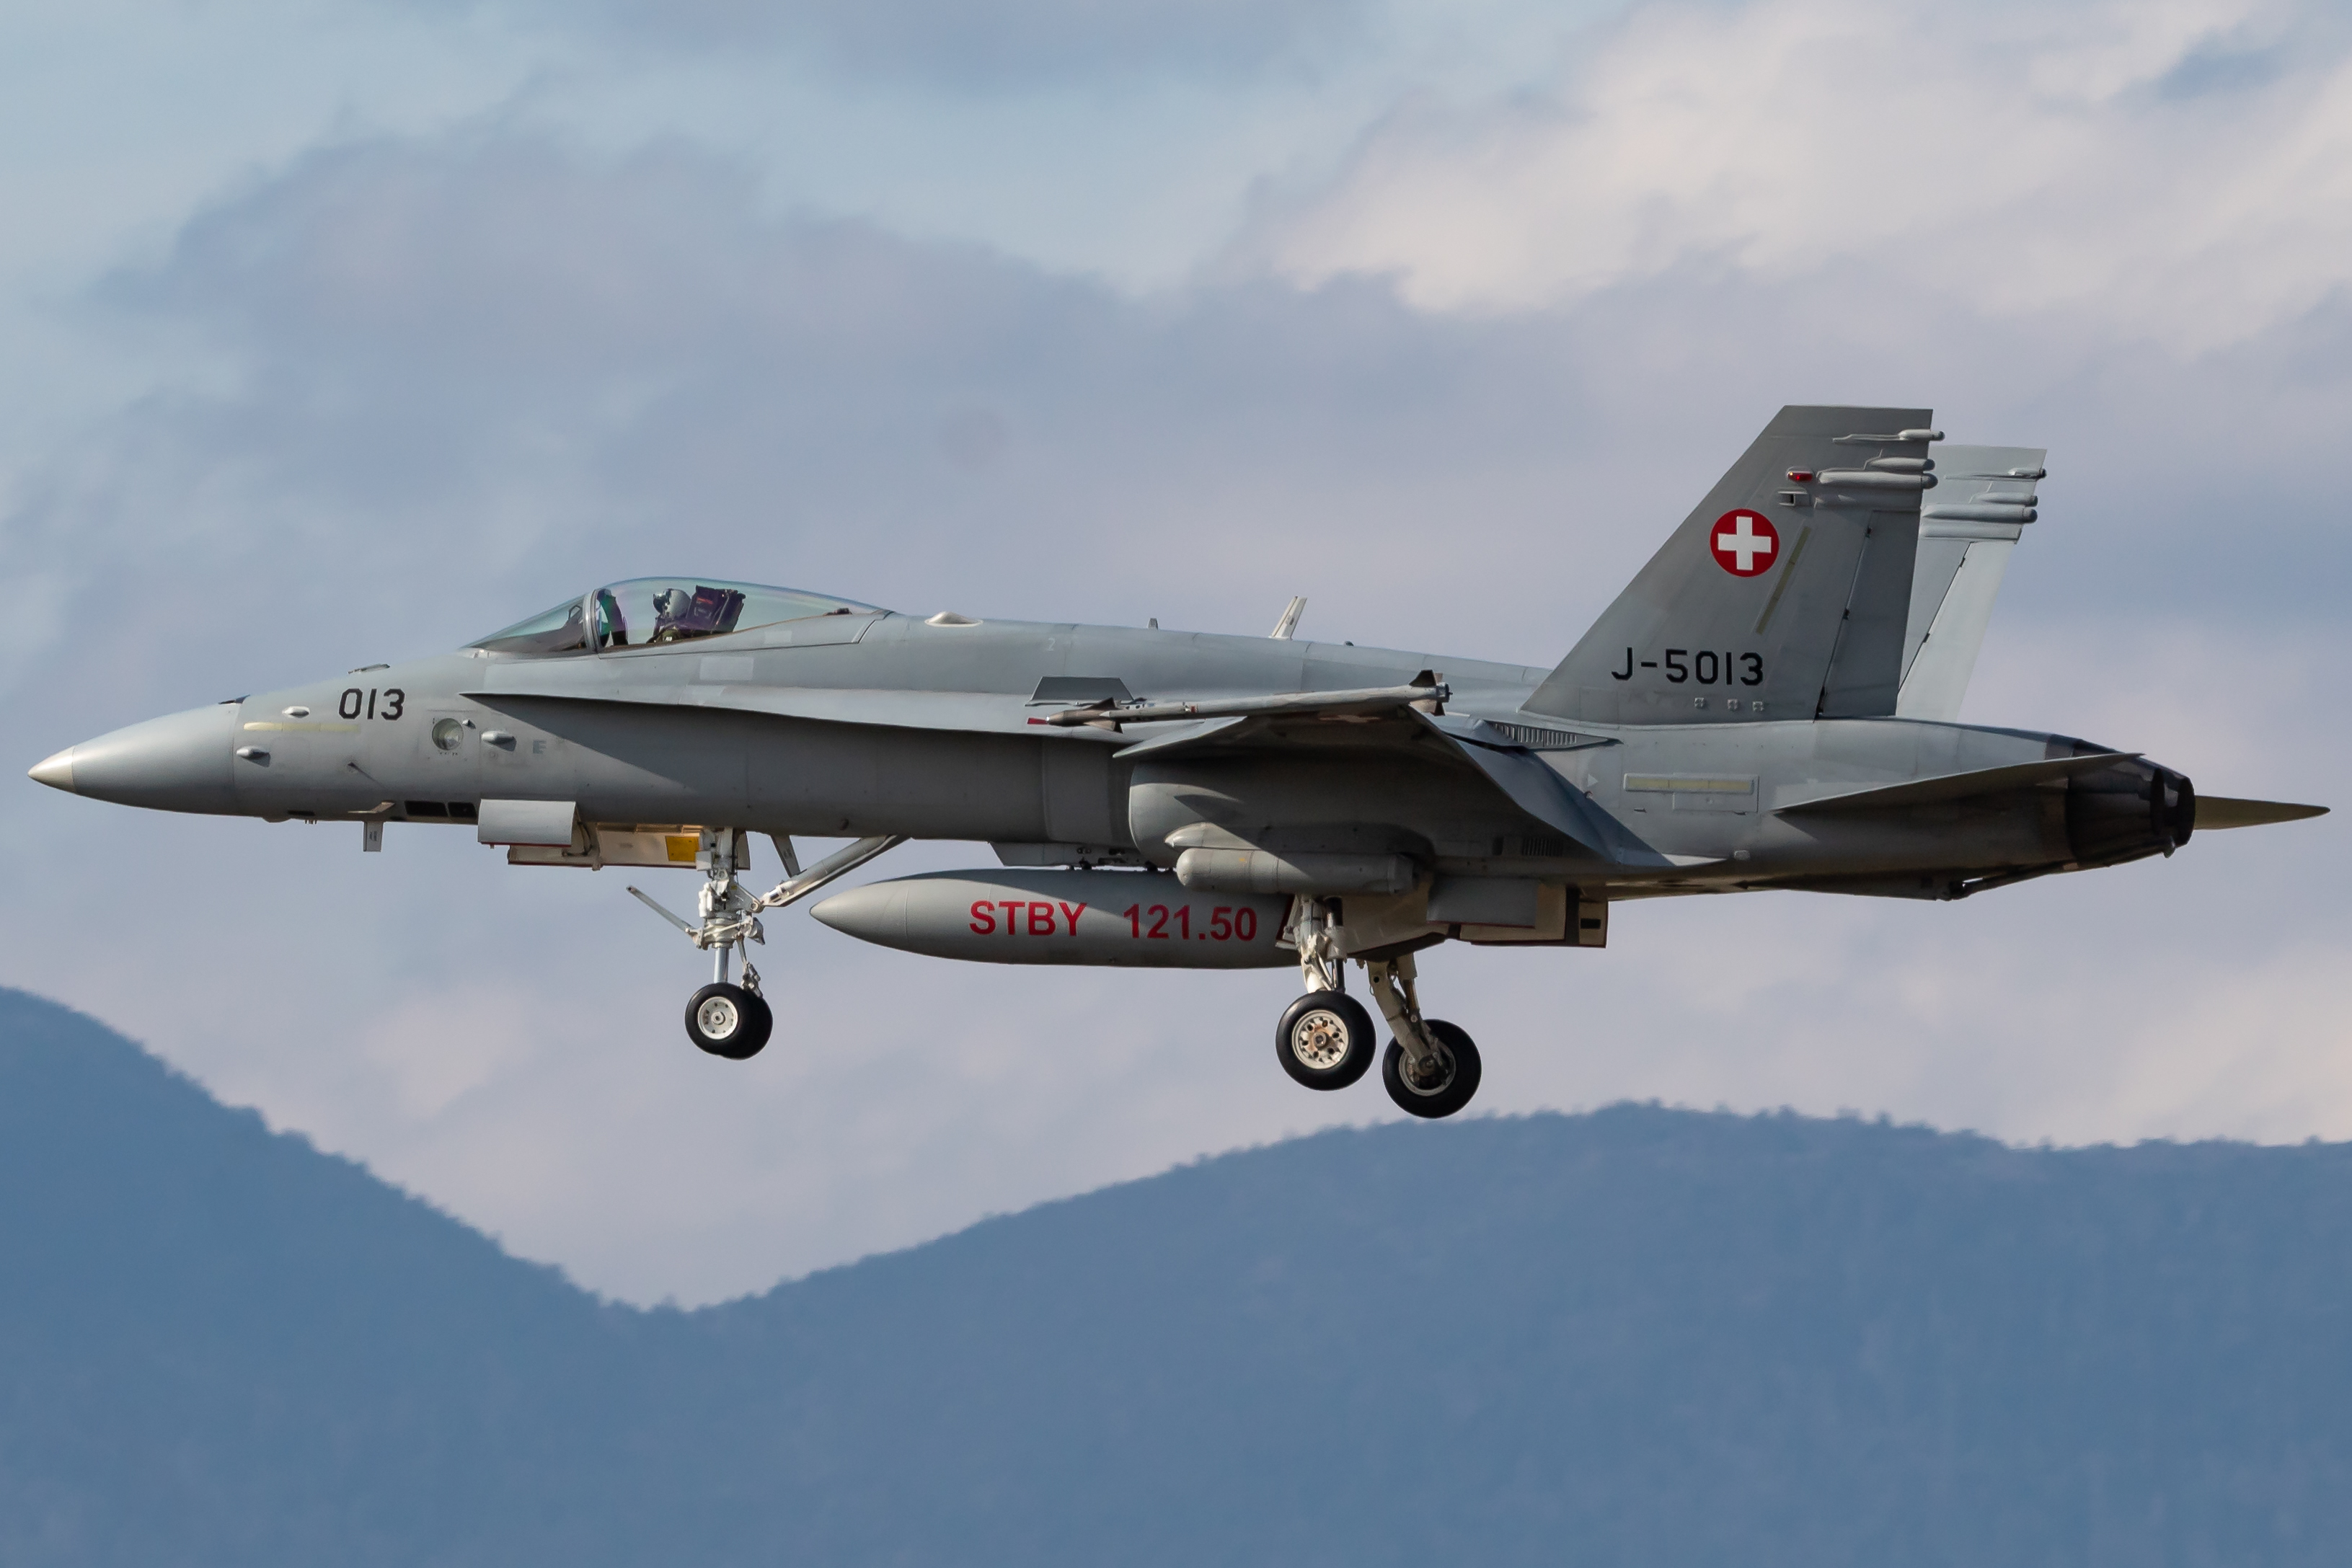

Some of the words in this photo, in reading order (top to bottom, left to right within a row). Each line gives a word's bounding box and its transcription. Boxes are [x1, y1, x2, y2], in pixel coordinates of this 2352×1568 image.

[1612, 647, 1763, 686] J-5013
[339, 688, 404, 720] 013
[970, 900, 1087, 936] STBY
[1123, 903, 1257, 941] 121.50
